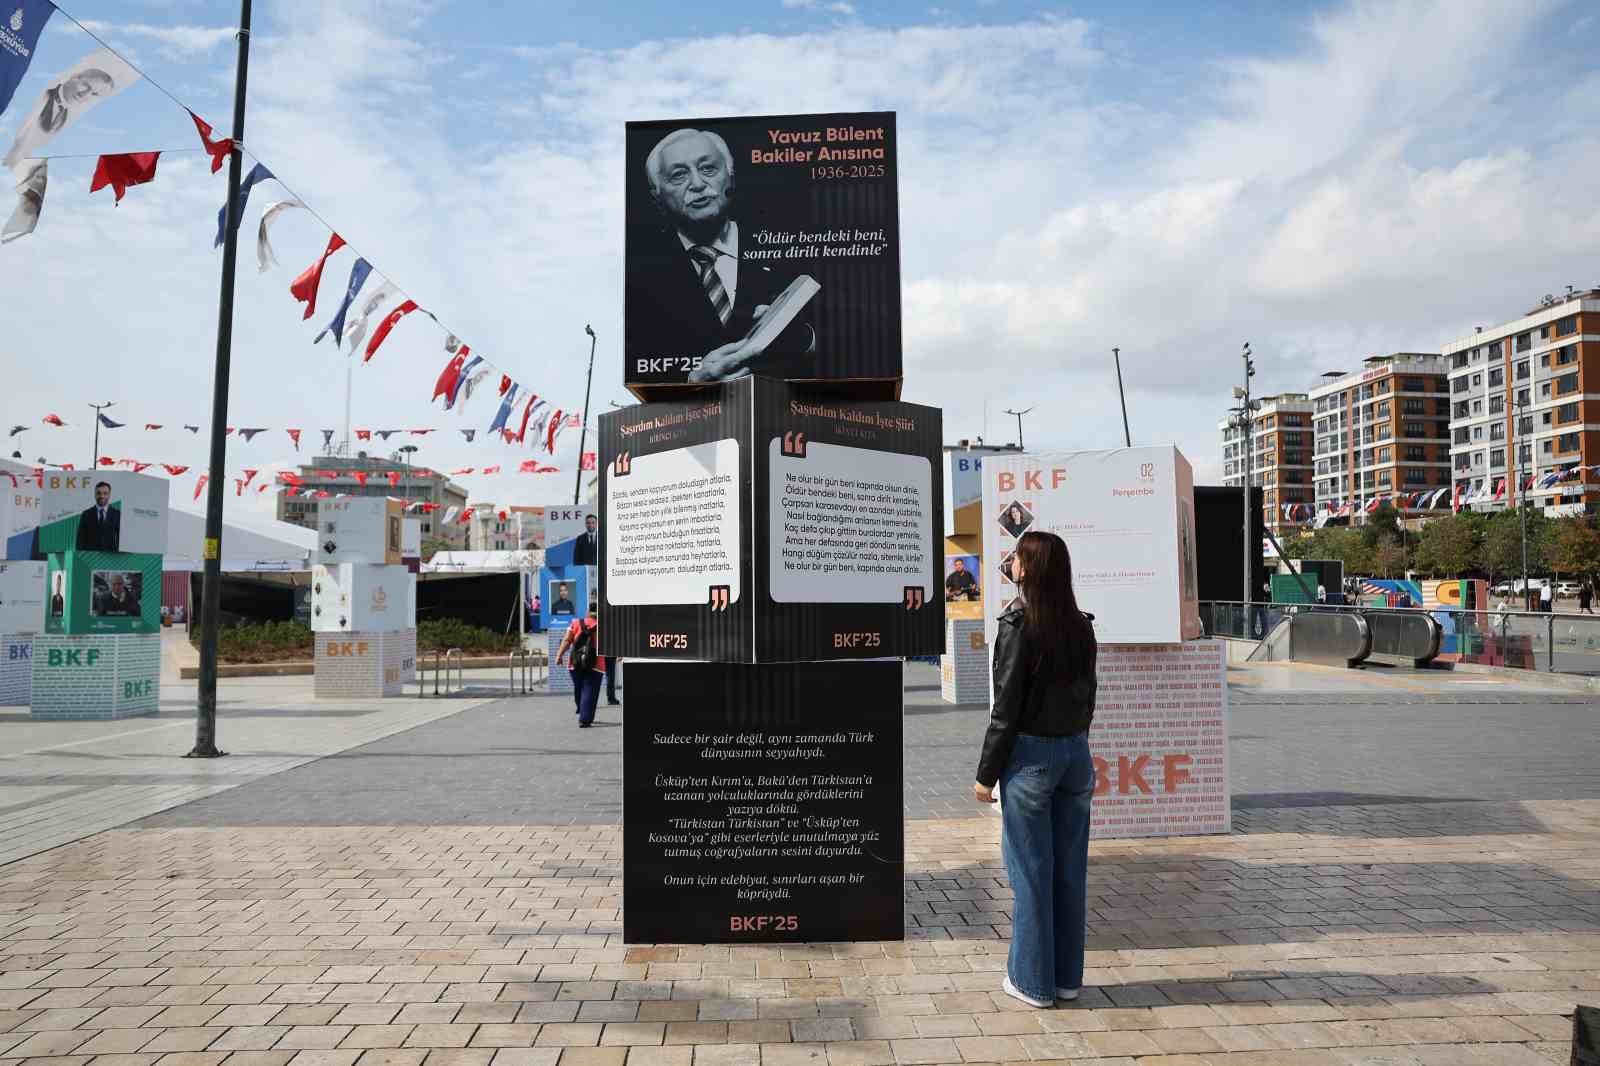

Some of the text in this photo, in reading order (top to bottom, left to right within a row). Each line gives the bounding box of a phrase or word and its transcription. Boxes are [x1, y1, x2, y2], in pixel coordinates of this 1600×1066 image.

[768, 127, 884, 144] Yavuz Bülent
[751, 146, 884, 164] Bakiler Anısına
[811, 166, 885, 179] 1936-2025
[799, 230, 851, 243] bendeki
[854, 228, 886, 243] beni,
[744, 247, 781, 260] sonra
[785, 245, 819, 259] dirilt
[790, 400, 914, 432] Şaşırdım Kaldım İşte Şiiri
[1141, 463, 1153, 477] 02
[50, 476, 92, 489] BKF
[786, 473, 796, 481] Ne
[798, 474, 812, 483] olur
[813, 476, 824, 484] bir
[825, 478, 838, 487] gün
[840, 479, 855, 487] beni
[856, 480, 883, 492] kapında
[884, 482, 901, 492] olsun
[998, 468, 1067, 492] BKF
[14, 495, 41, 508] BKF
[551, 510, 582, 521] BKF
[9, 645, 32, 660] BK
[326, 642, 369, 656] BKF
[48, 649, 101, 667] BKF
[124, 680, 152, 698] BKF
[653, 732, 692, 745] Sadece
[694, 732, 710, 744] bir
[712, 732, 734, 746] şair
[767, 734, 793, 746] aynı
[795, 732, 845, 744] zamanda
[848, 732, 874, 744] Türk
[701, 746, 825, 760] dünyasının seyyahıydı.
[1093, 754, 1194, 795] BKF
[663, 788, 864, 803] uzanan yolculuklarında gördüklerini
[726, 802, 799, 817] yazıya döktü.
[787, 818, 799, 828] ve
[710, 832, 732, 845] gibi
[734, 832, 790, 845] eserleriyle
[792, 832, 858, 845] unutulmaya
[860, 832, 880, 843] yüz
[664, 845, 864, 860] tutmuş coğrafyaların sesini duyurdu.
[664, 873, 864, 888] Onun için edebiyat, sınırları aşan bir
[737, 888, 792, 902] köprüydü.
